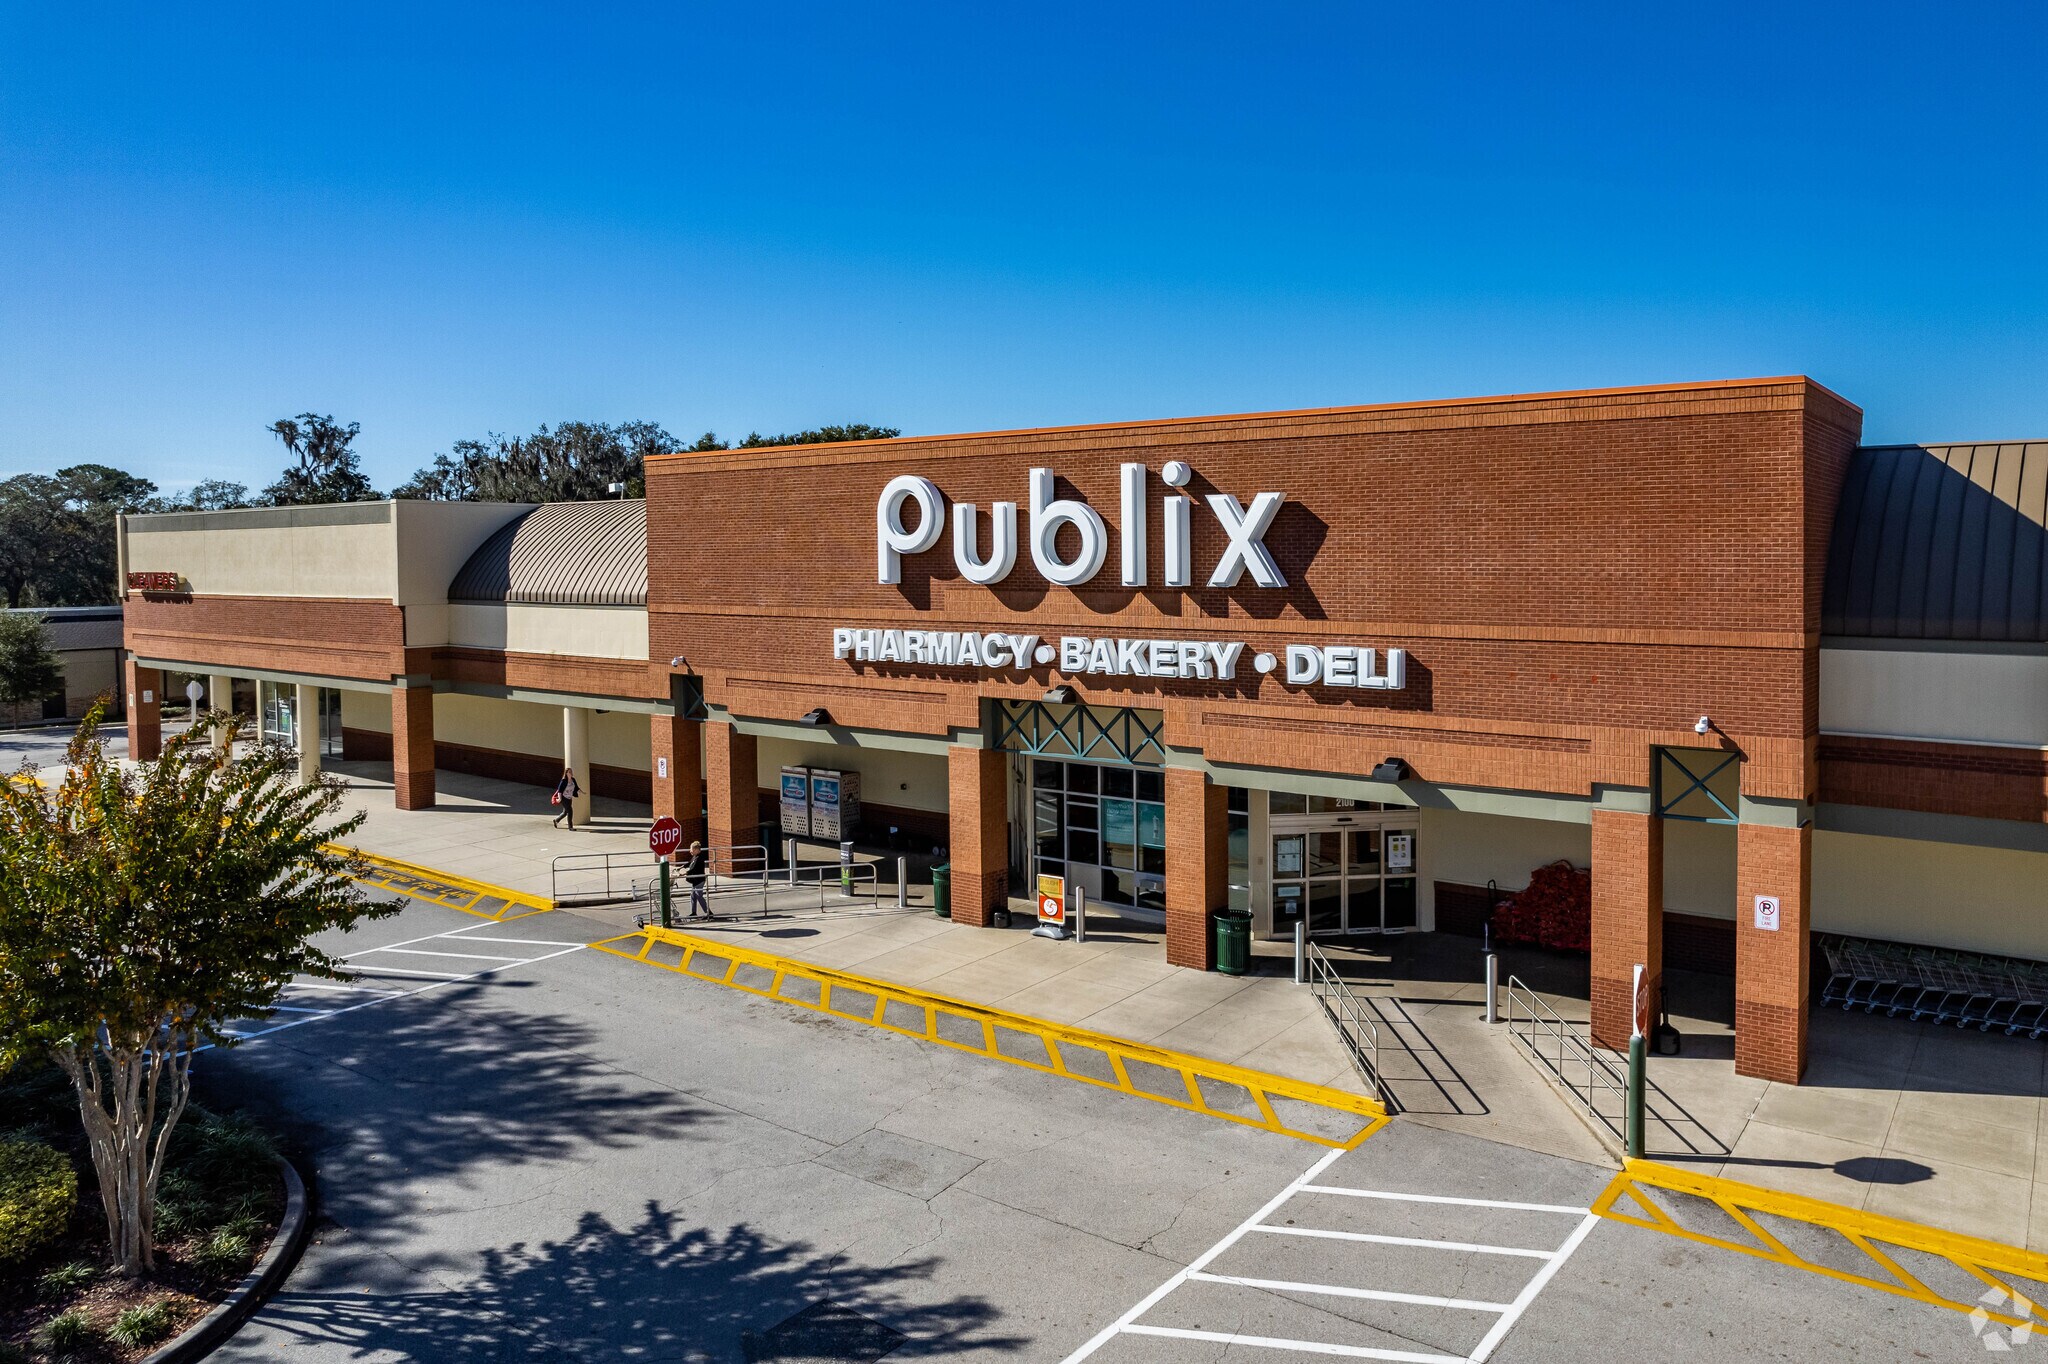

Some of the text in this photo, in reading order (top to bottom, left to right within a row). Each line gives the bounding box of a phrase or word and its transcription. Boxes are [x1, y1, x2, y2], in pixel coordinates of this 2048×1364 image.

[877, 460, 1289, 588] Publix
[833, 628, 1406, 690] PHARMACY BAKERY DELI
[651, 827, 679, 846] STOP
[1636, 984, 1648, 1017] STOP
